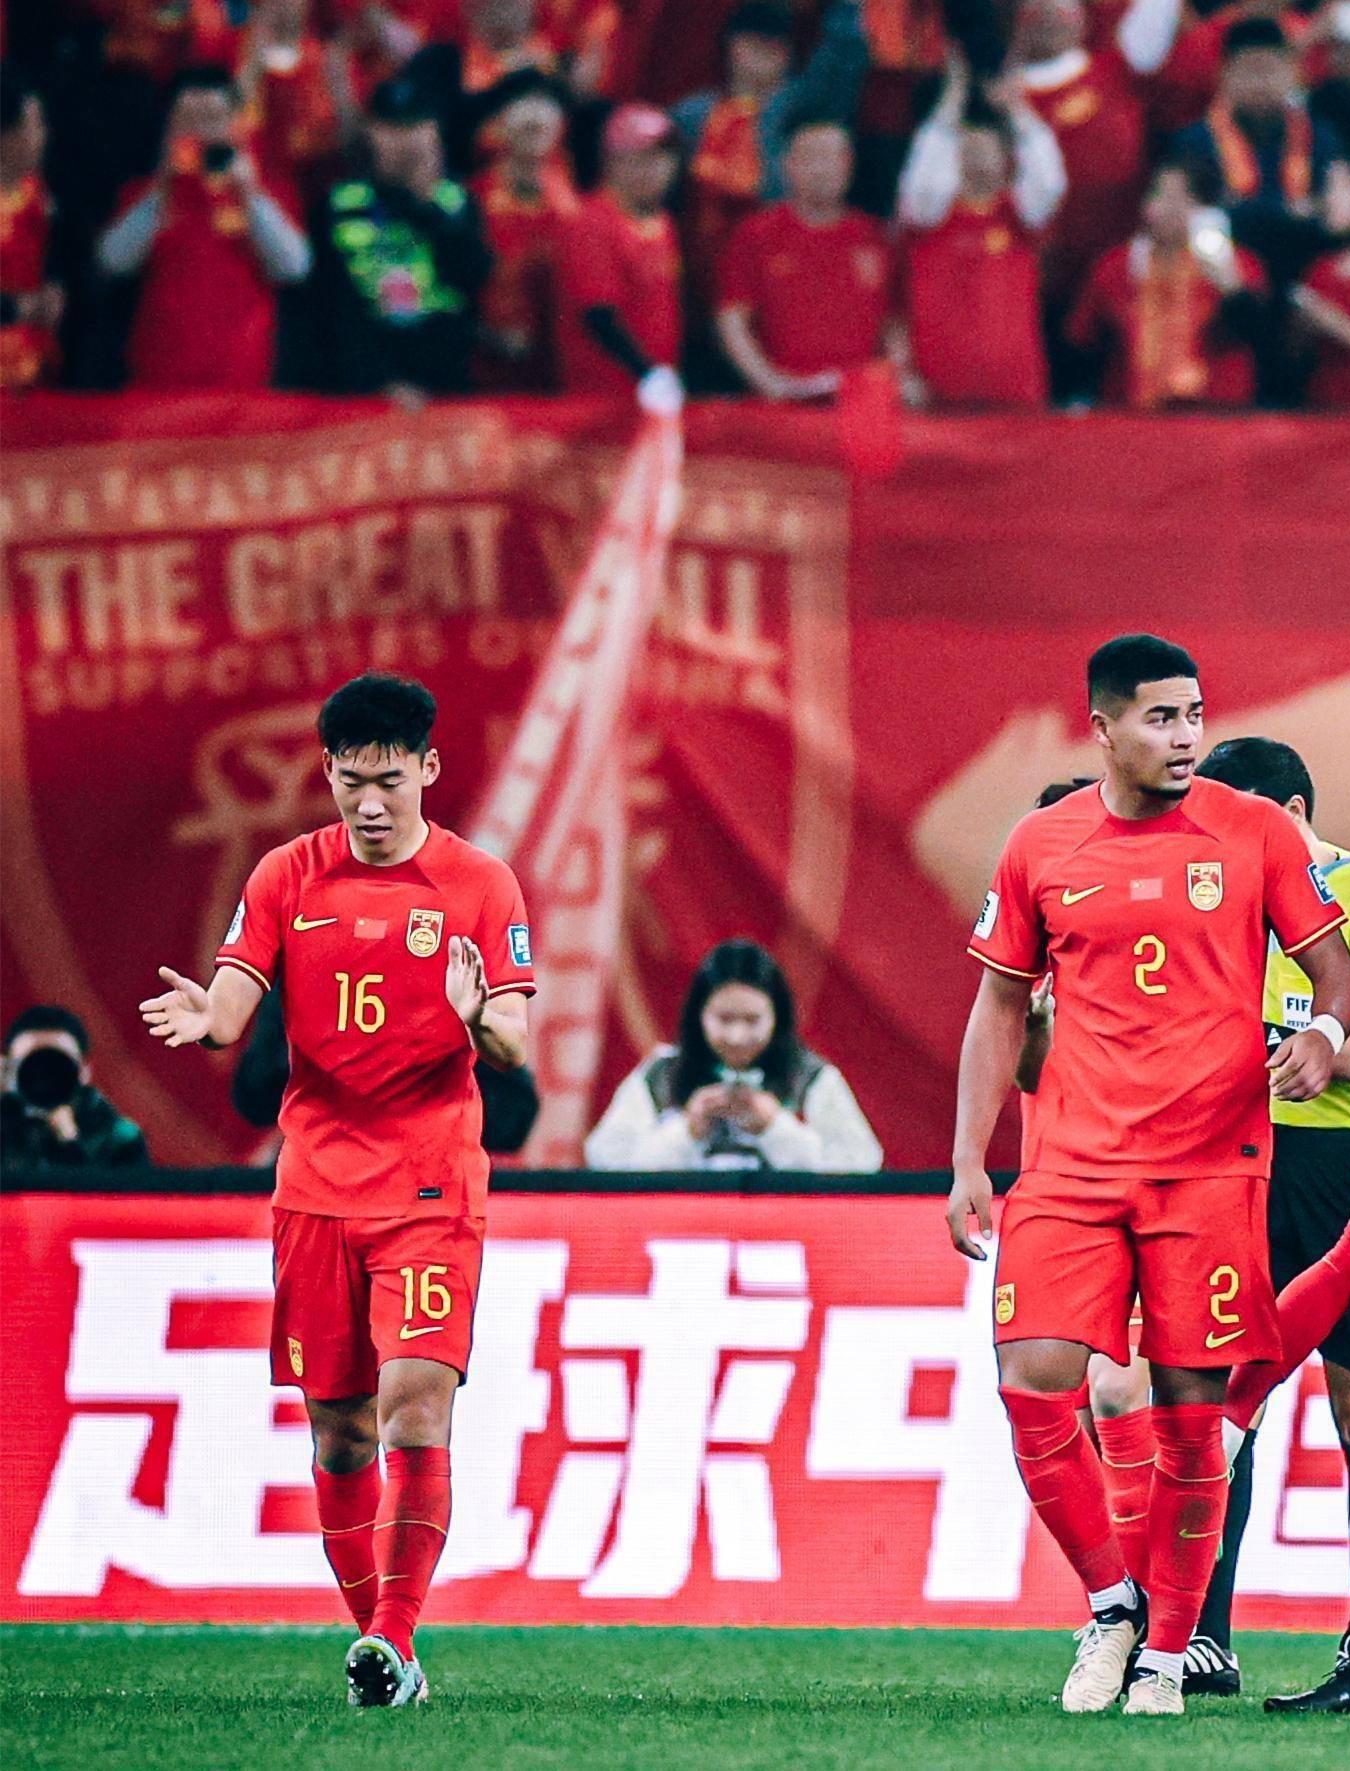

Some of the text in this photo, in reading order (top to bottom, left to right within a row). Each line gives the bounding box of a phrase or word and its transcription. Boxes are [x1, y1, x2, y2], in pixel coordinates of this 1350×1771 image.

[19, 540, 203, 652] THE
[226, 503, 508, 637] GREAT
[1133, 934, 1168, 995] 2
[334, 971, 386, 1034] 16
[1286, 997, 1311, 1012] FIF
[399, 1264, 452, 1321] 16
[1208, 1265, 1241, 1325] 2
